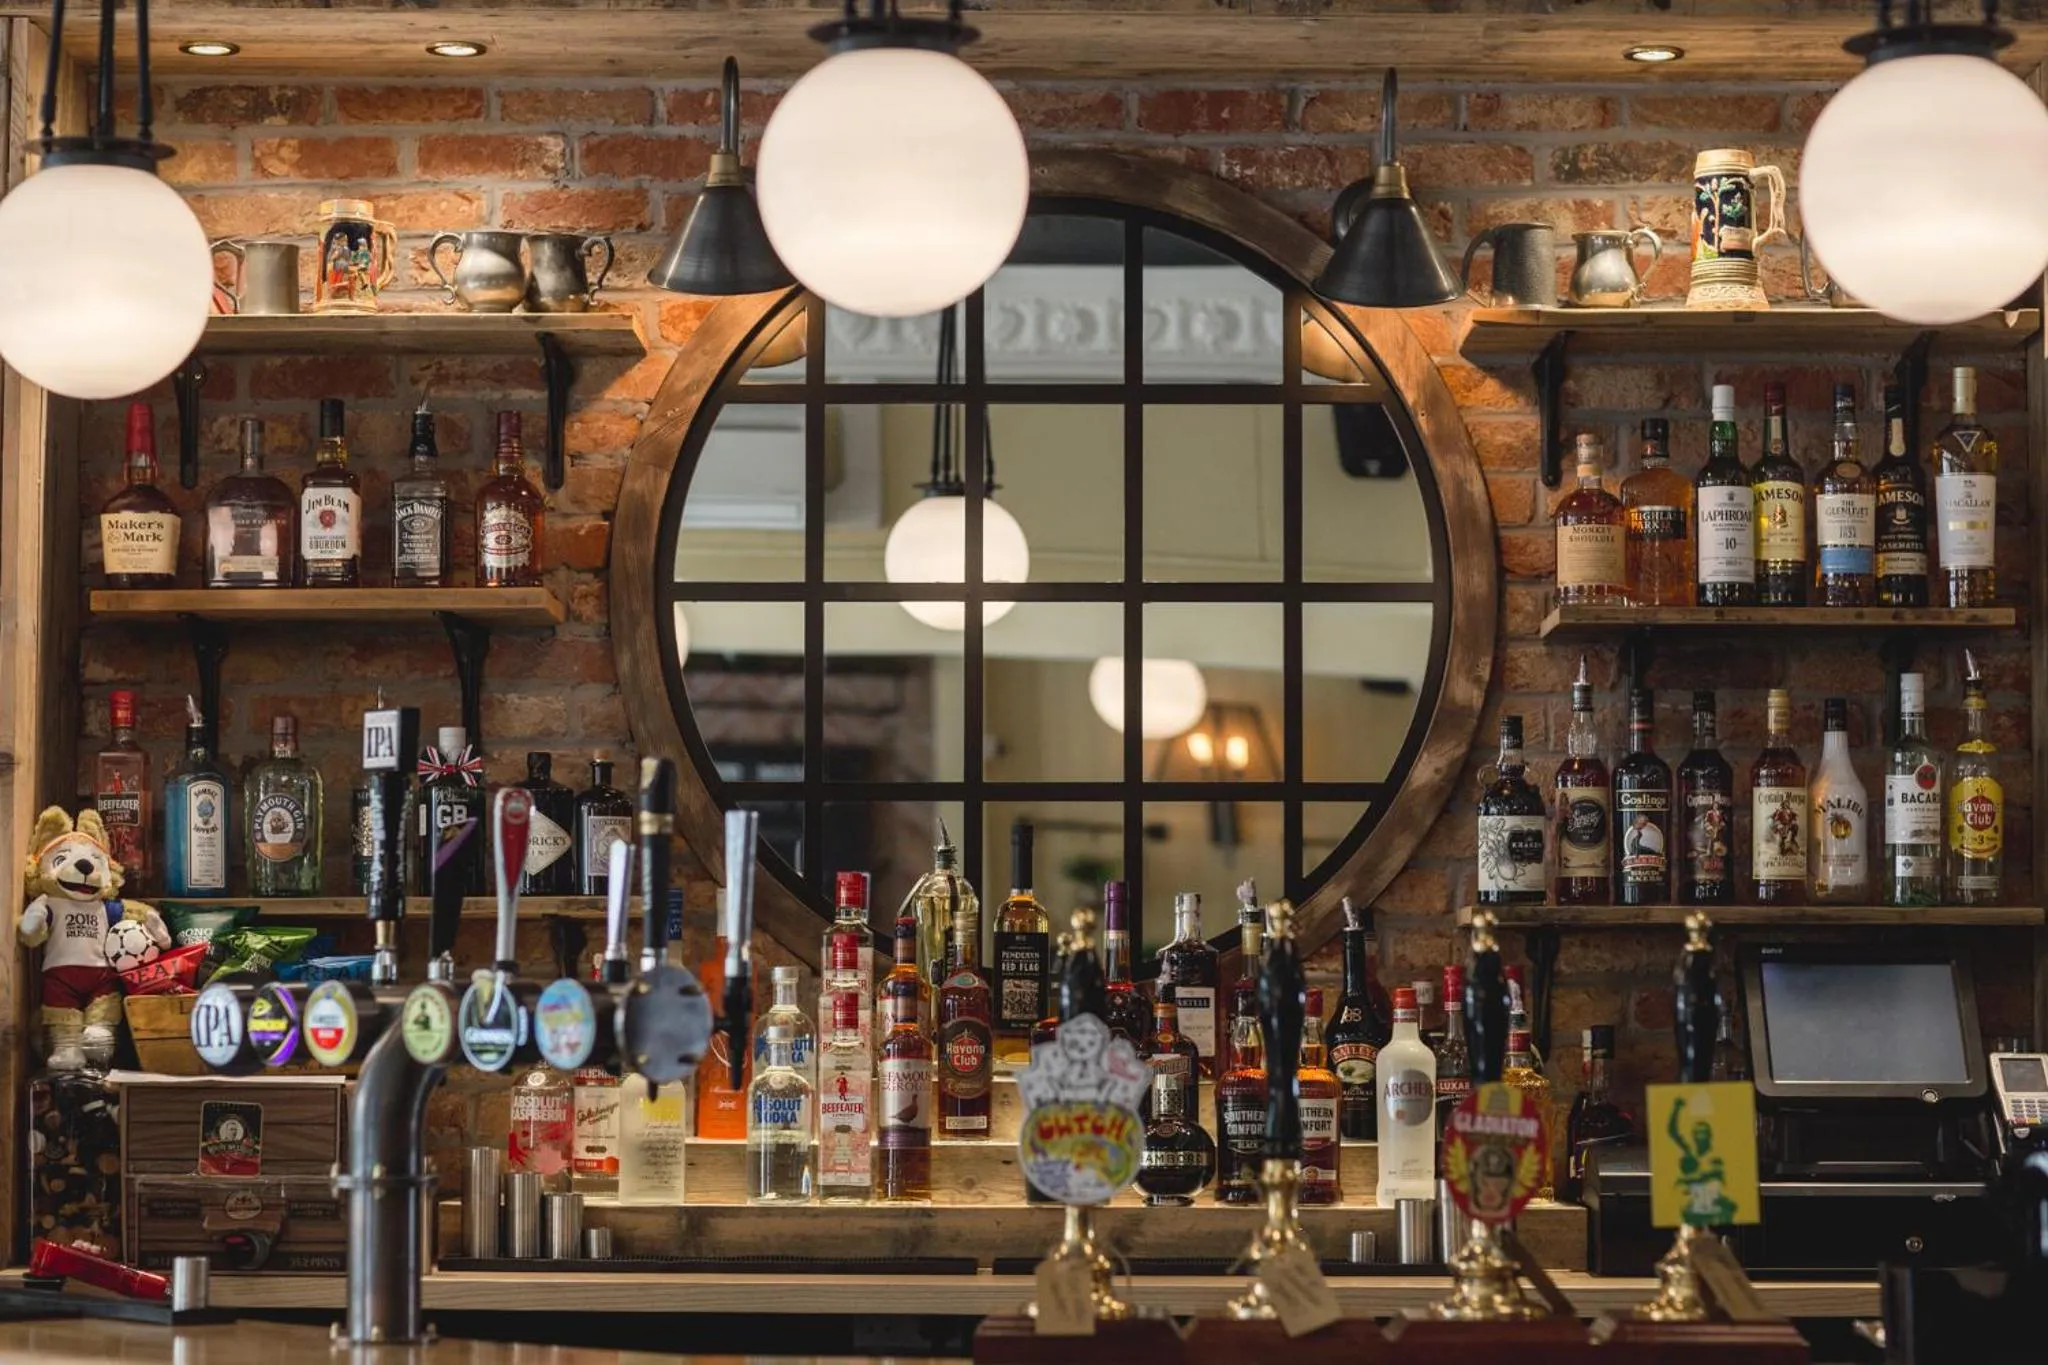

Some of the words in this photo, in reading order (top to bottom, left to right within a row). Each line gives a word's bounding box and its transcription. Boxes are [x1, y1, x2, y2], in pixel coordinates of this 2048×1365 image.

[305, 496, 322, 514] JIM
[324, 495, 350, 513] BEAM
[395, 504, 414, 520] JACK
[107, 519, 165, 530] Maker's
[1572, 526, 1613, 534] MONKEY
[122, 532, 163, 543] Mark
[1724, 537, 1737, 550] 10
[309, 539, 347, 550] BOURBON
[366, 727, 395, 758] IPA
[98, 799, 140, 811] BEEFEATER
[254, 796, 296, 830] PLYMOUTH
[436, 805, 468, 829] GB
[1965, 812, 1992, 825] Club
[1977, 835, 1984, 845] 3
[65, 913, 99, 926] 2018
[1001, 962, 1016, 971] RED
[1019, 962, 1040, 971] FLAG
[196, 1003, 238, 1048] IPA
[946, 1043, 986, 1055] Havana
[1333, 1044, 1377, 1060] BAILEYS
[953, 1054, 978, 1066] Club
[514, 1096, 561, 1109] ABSOLUT
[754, 1096, 802, 1111] ABSOLUT
[821, 1102, 865, 1114] BEEFEATER
[757, 1111, 798, 1124] VODKA
[1223, 1110, 1266, 1123] SOUTHER
[1145, 1151, 1203, 1164] AMBORD
